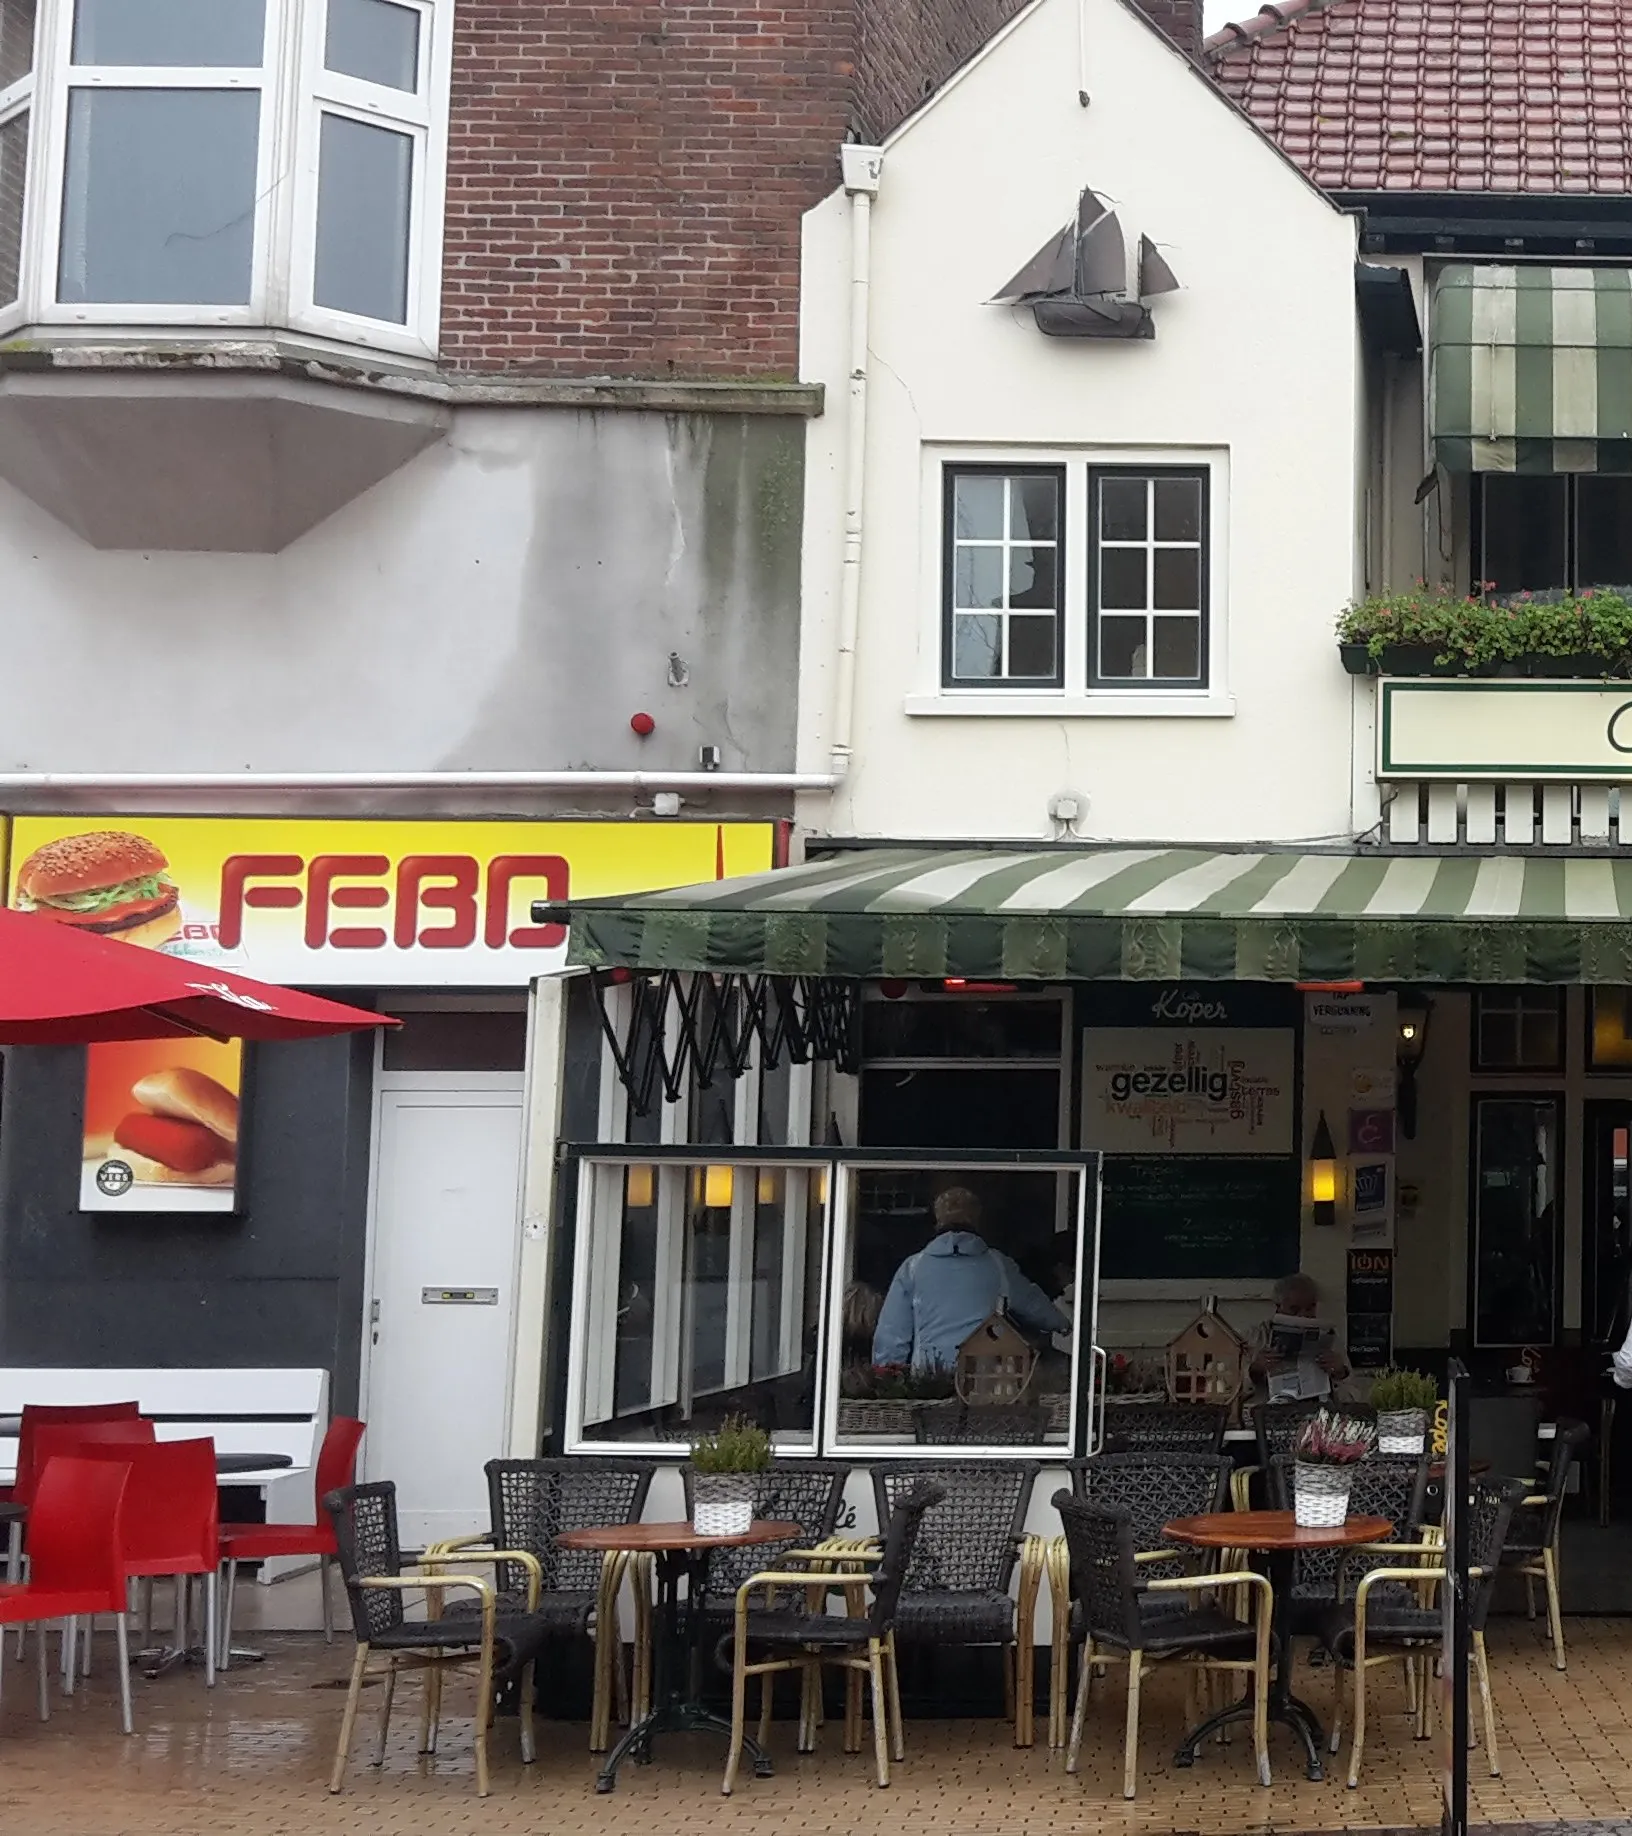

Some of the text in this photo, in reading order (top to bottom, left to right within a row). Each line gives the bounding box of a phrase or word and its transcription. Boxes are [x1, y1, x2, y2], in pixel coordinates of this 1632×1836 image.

[218, 854, 570, 949] FEBO
[1151, 988, 1228, 1024] Koper
[1110, 1065, 1229, 1102] gezellig
